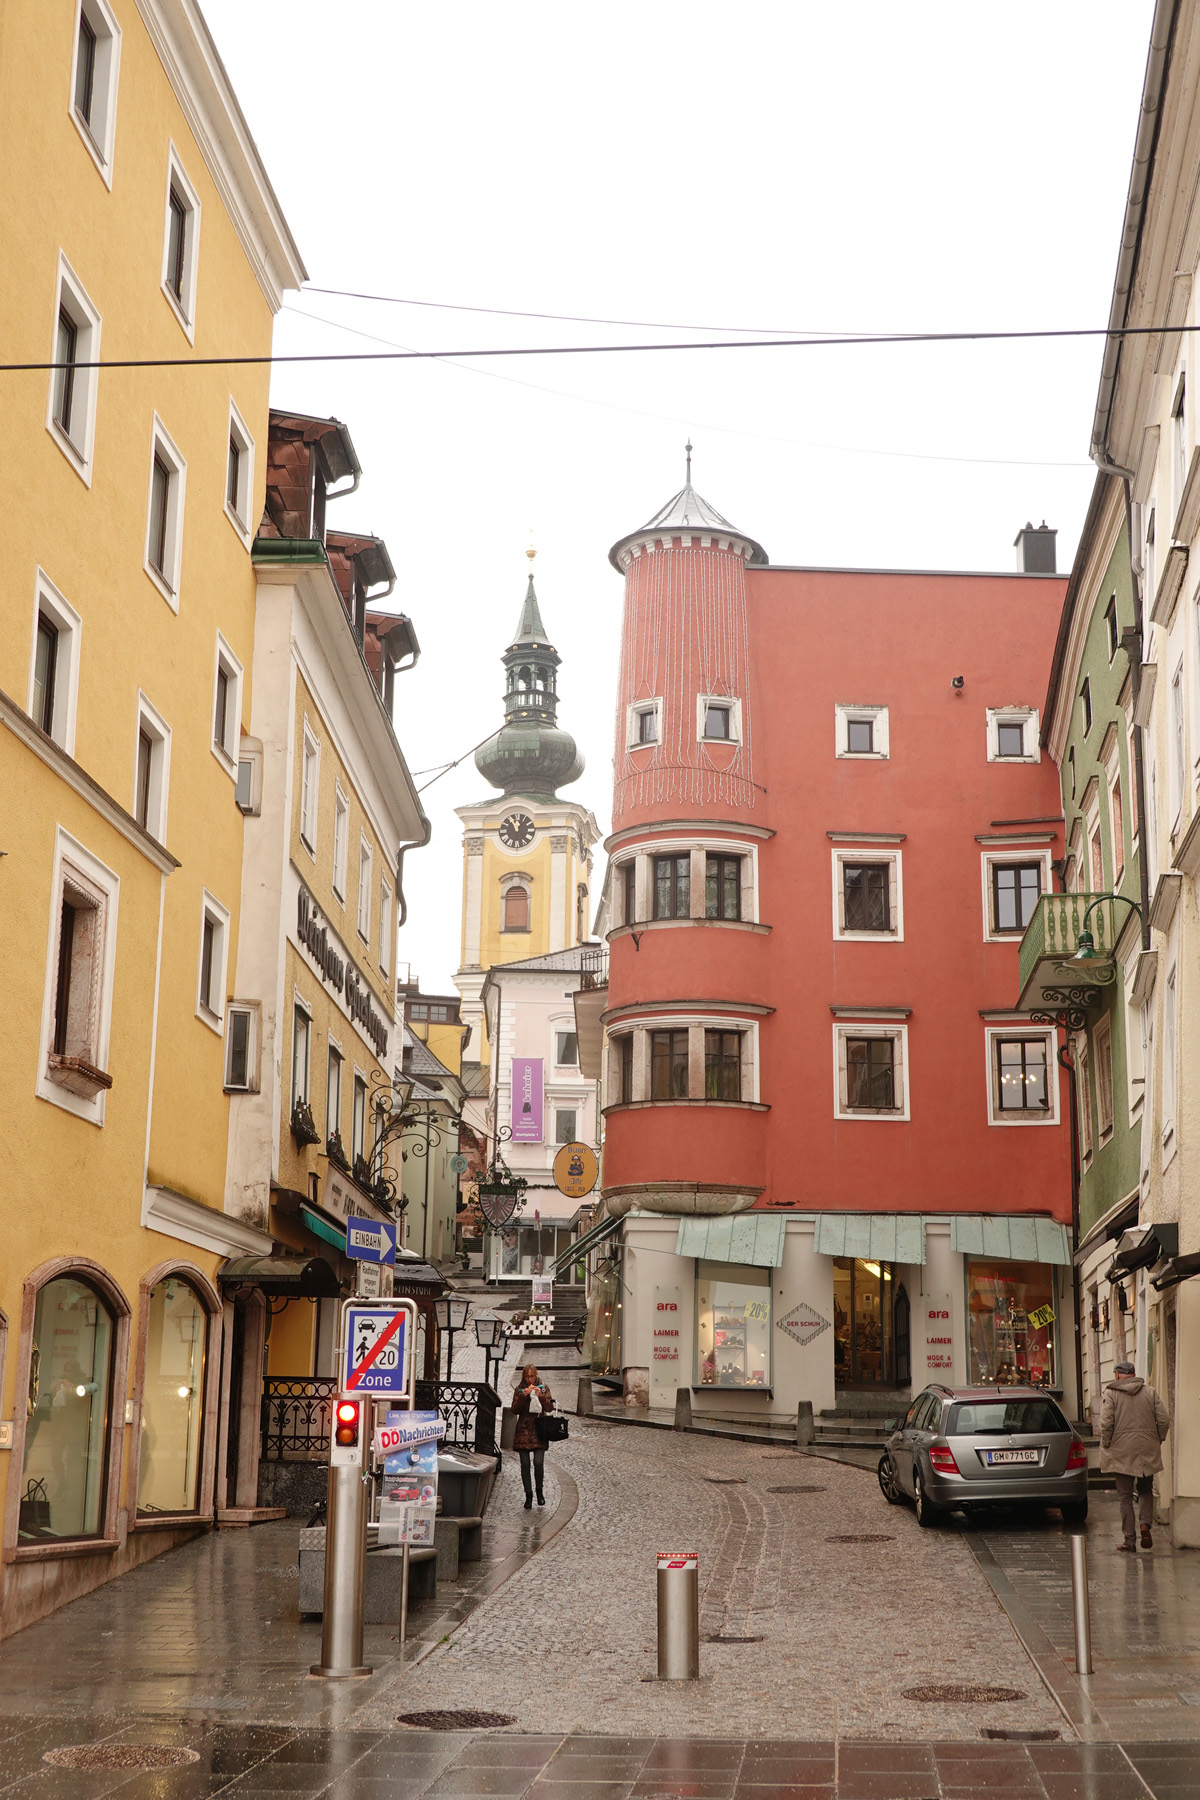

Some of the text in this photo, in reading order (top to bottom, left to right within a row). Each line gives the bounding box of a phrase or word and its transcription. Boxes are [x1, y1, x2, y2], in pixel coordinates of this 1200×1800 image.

[355, 1231, 381, 1248] EINBAHN
[656, 1302, 678, 1311] ara
[928, 1310, 949, 1319] ara
[379, 1350, 395, 1365] 20
[357, 1373, 392, 1386] Zone
[993, 1452, 1005, 1461] GM
